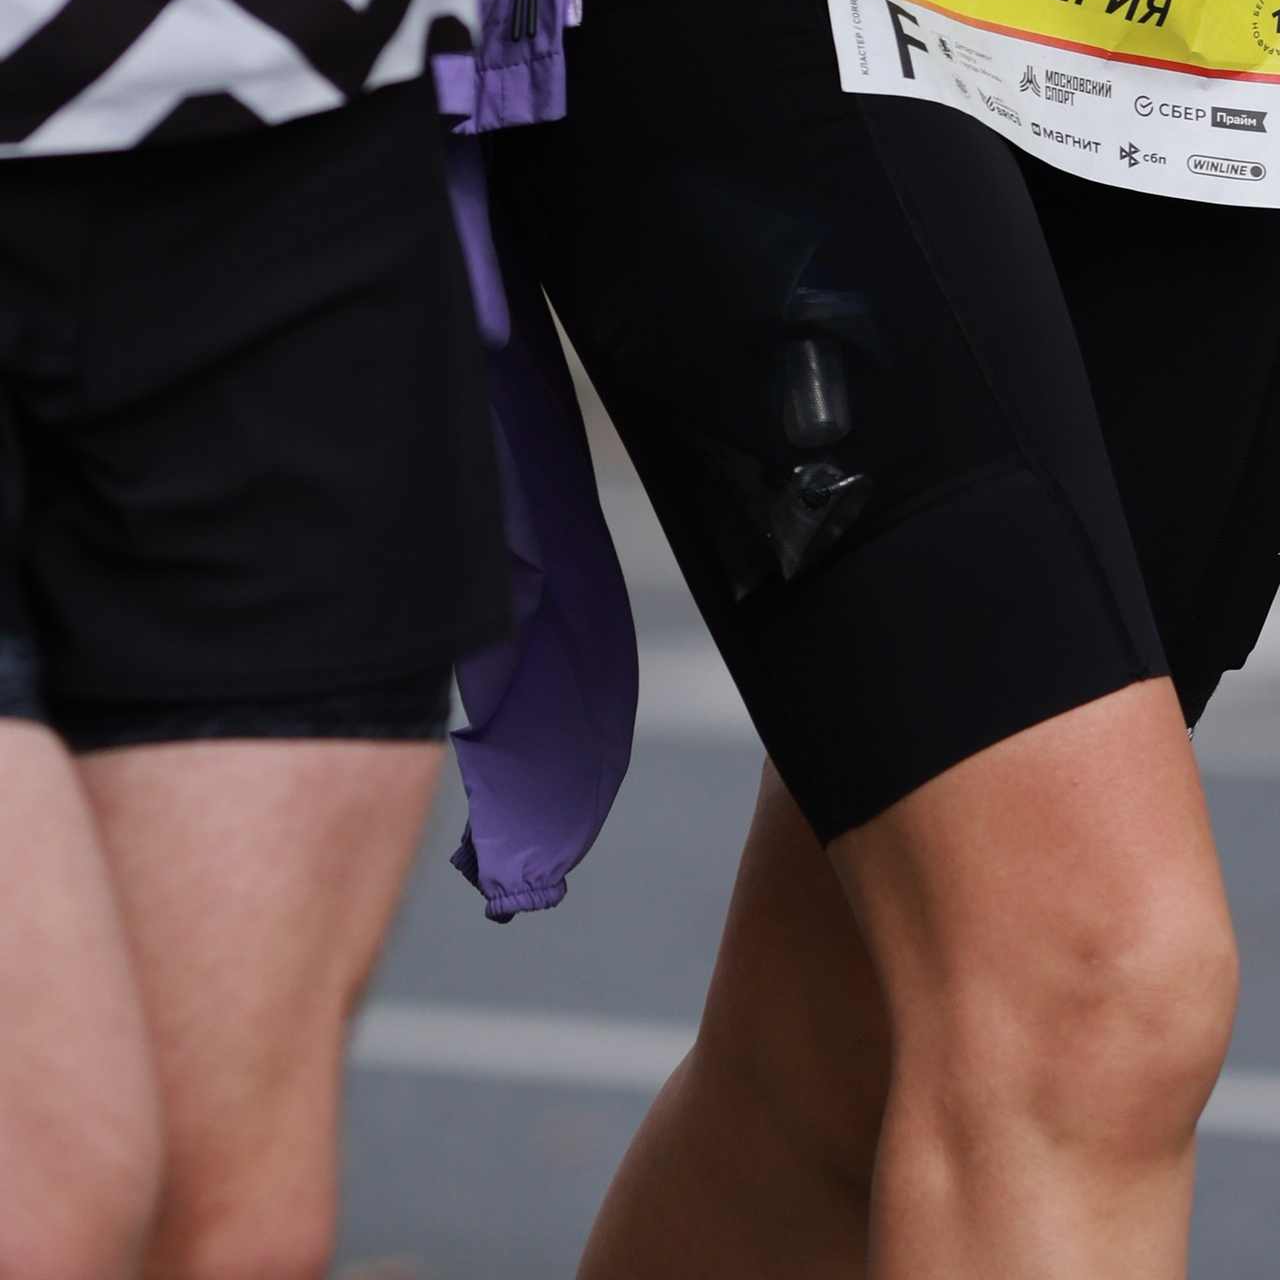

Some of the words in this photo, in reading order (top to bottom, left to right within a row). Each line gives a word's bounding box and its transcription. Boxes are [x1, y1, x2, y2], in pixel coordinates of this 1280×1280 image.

[1045, 69, 1112, 99] МОСКОВСКИЙ
[1044, 86, 1076, 107] СПОРТ
[1158, 102, 1206, 122] СБЕР
[1216, 112, 1257, 127] Прайм
[1193, 158, 1248, 176] WINLINE
